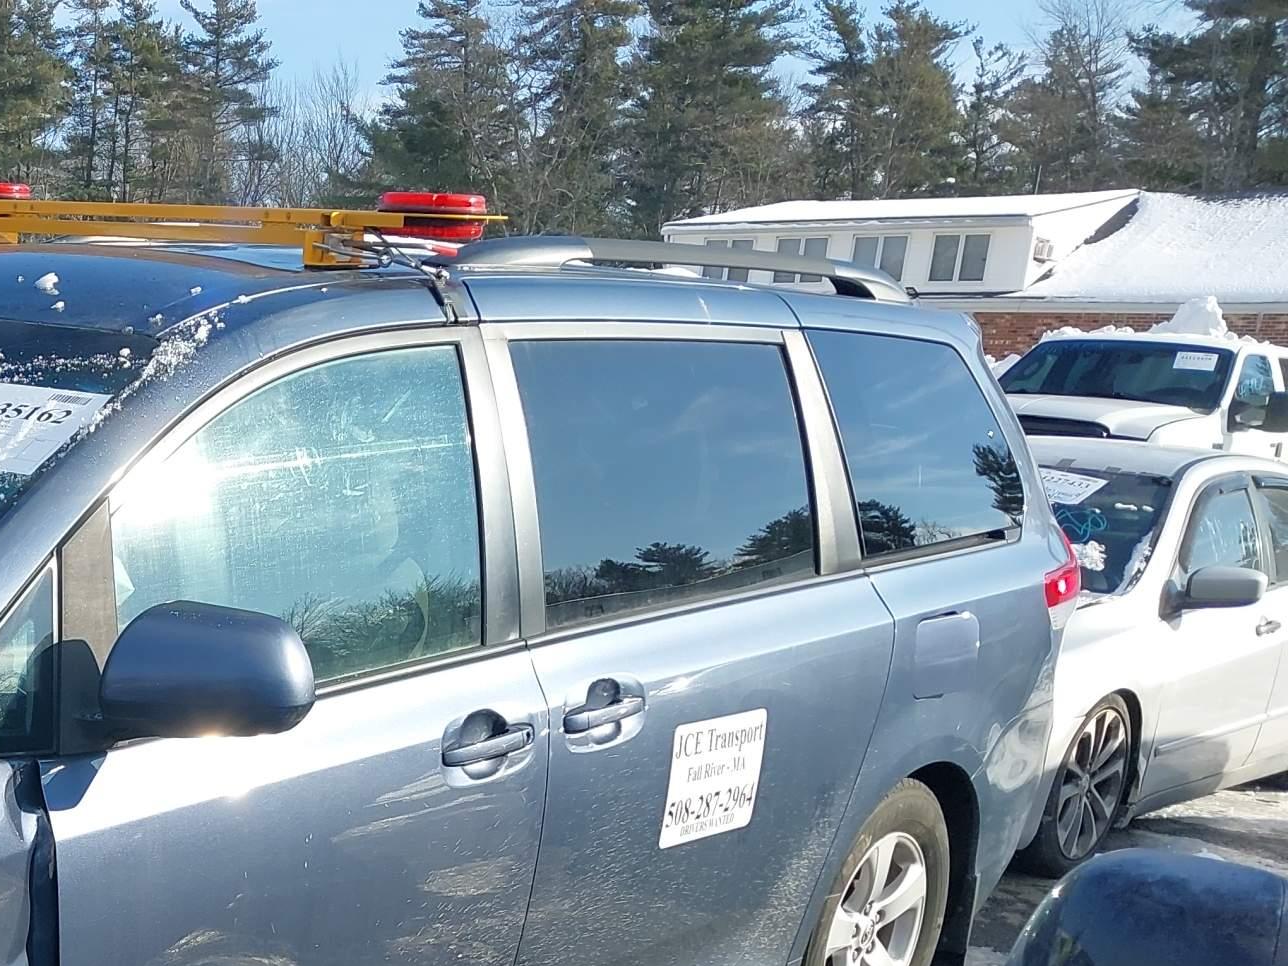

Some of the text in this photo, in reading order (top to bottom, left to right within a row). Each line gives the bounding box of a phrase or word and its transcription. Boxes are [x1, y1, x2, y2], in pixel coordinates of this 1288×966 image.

[707, 721, 764, 752] Transport
[687, 764, 703, 783] Fall
[704, 762, 725, 779] River
[731, 756, 746, 772] MA
[665, 781, 754, 828] 508-287-2964
[680, 822, 707, 837] DRIVERS
